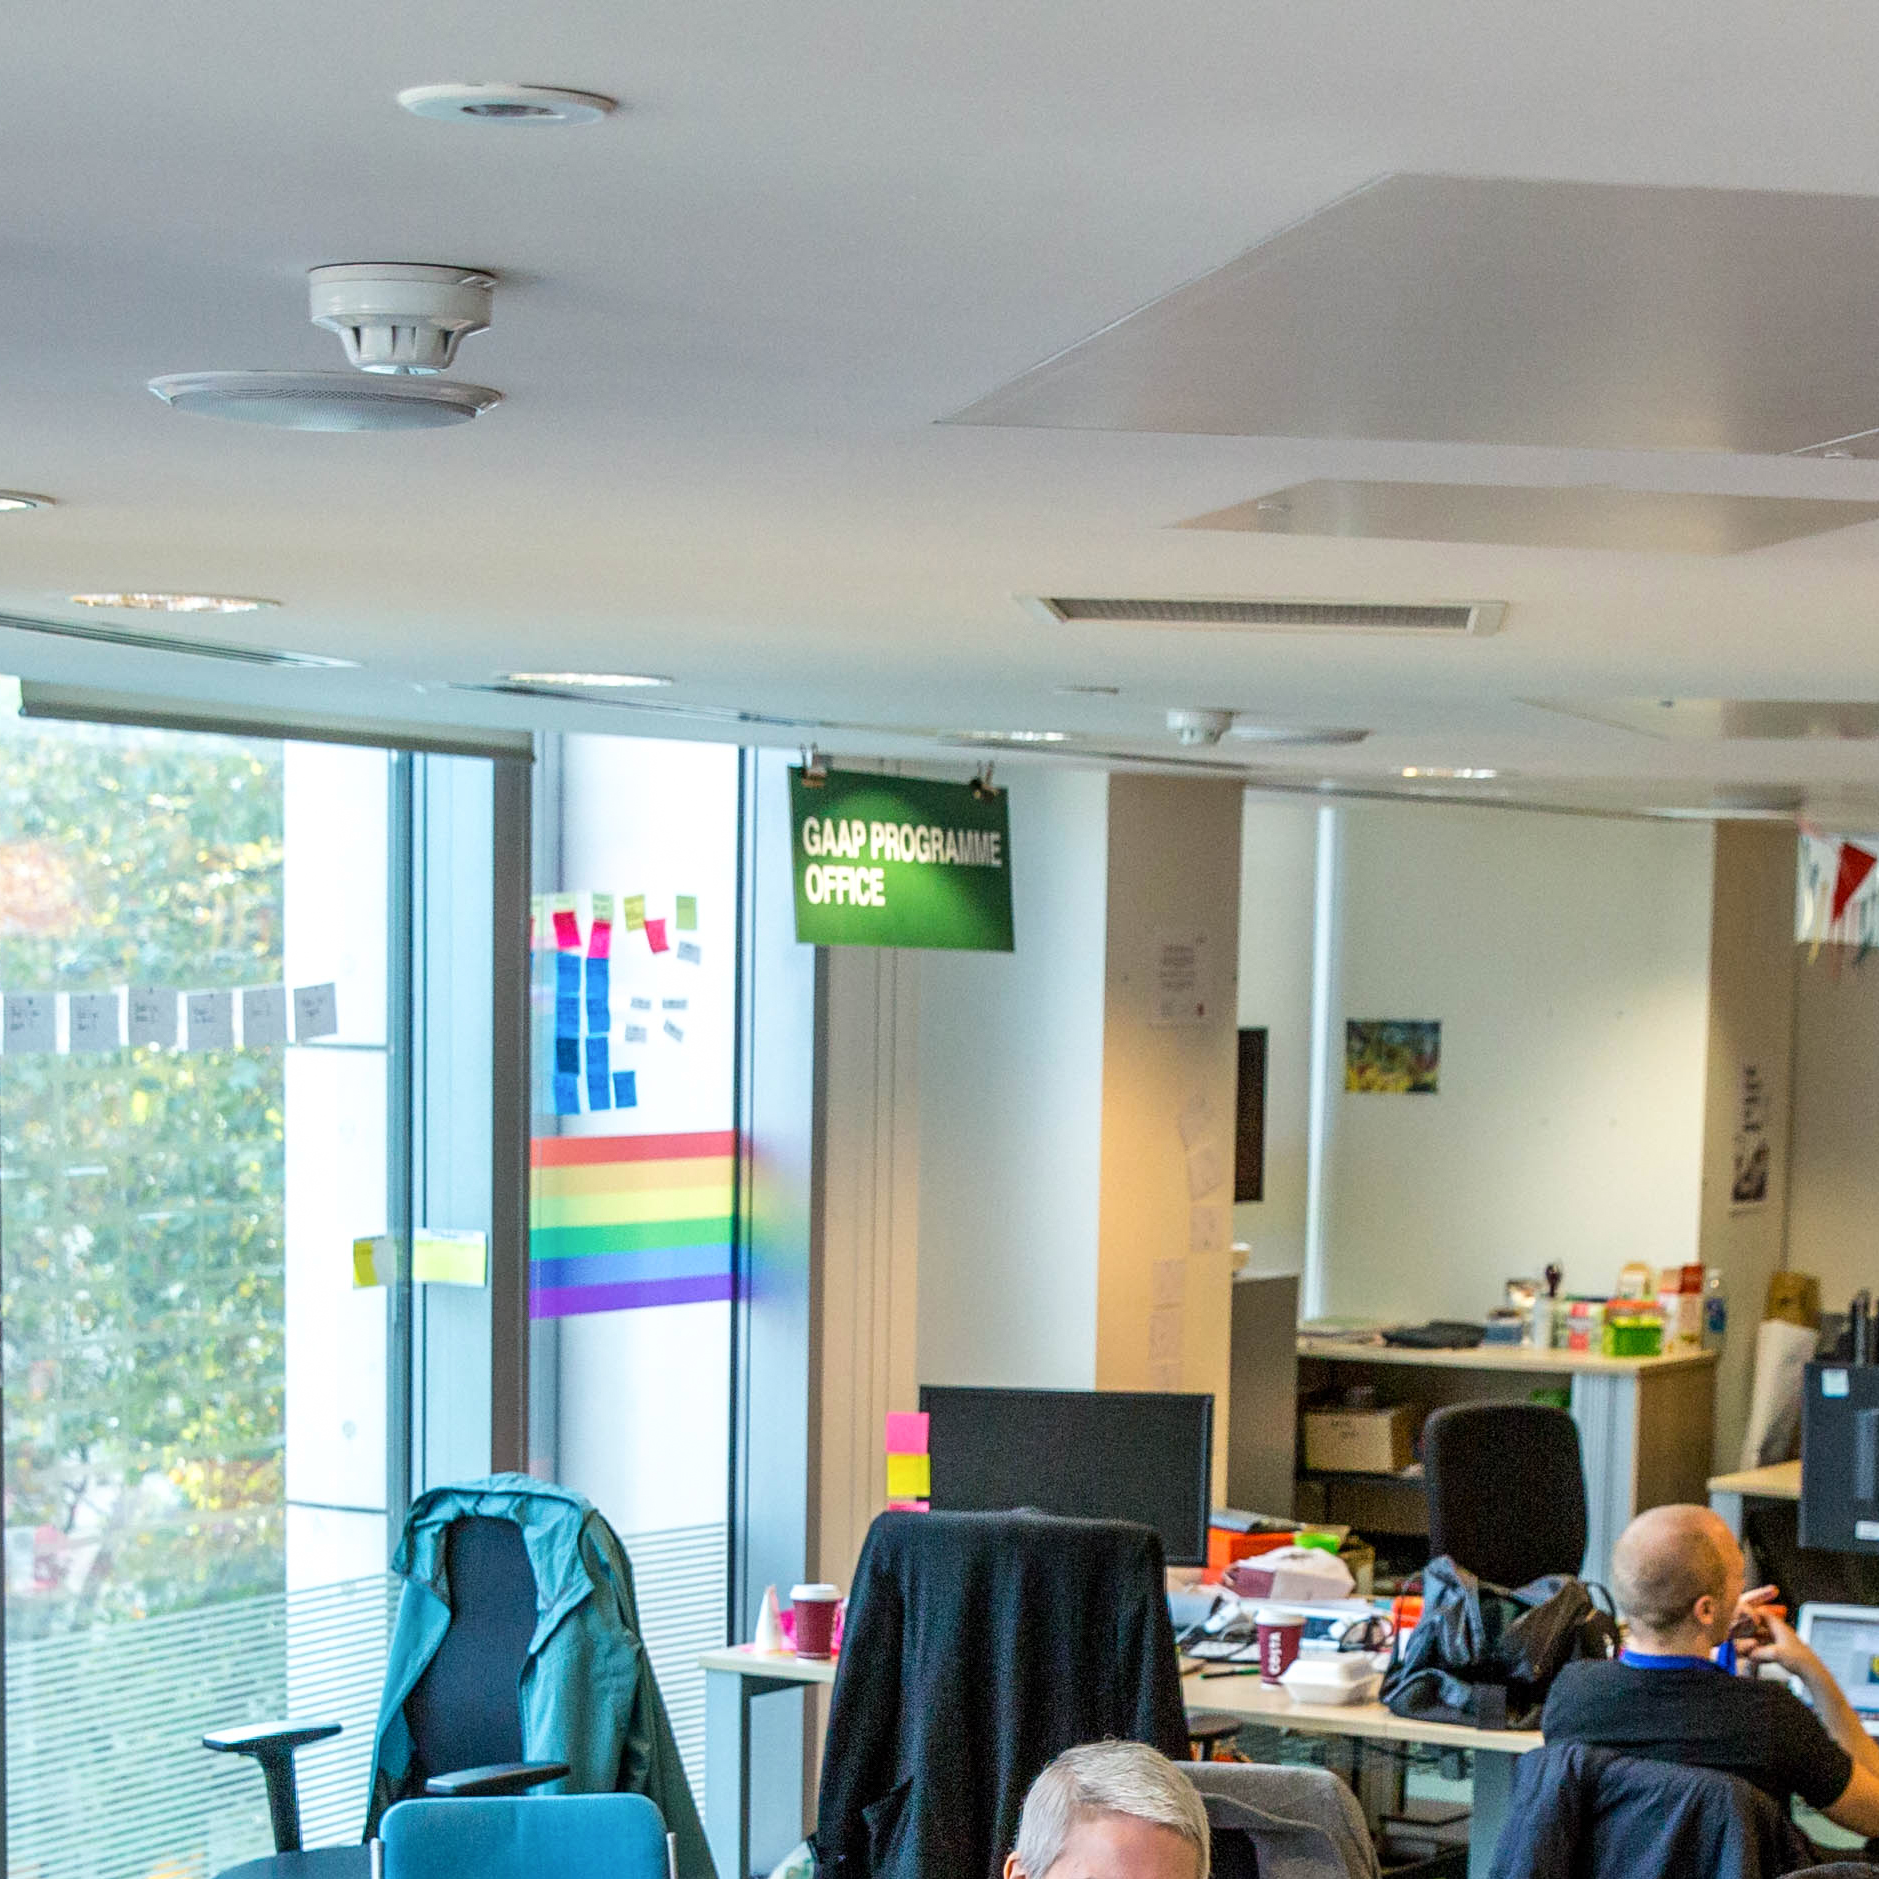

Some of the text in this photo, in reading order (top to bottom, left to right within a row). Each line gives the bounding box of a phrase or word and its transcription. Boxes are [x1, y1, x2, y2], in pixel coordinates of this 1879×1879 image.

[802, 816, 1002, 867] GAAP PROGRAMME
[805, 863, 886, 907] OFFICE
[1268, 1631, 1282, 1675] COSTA
